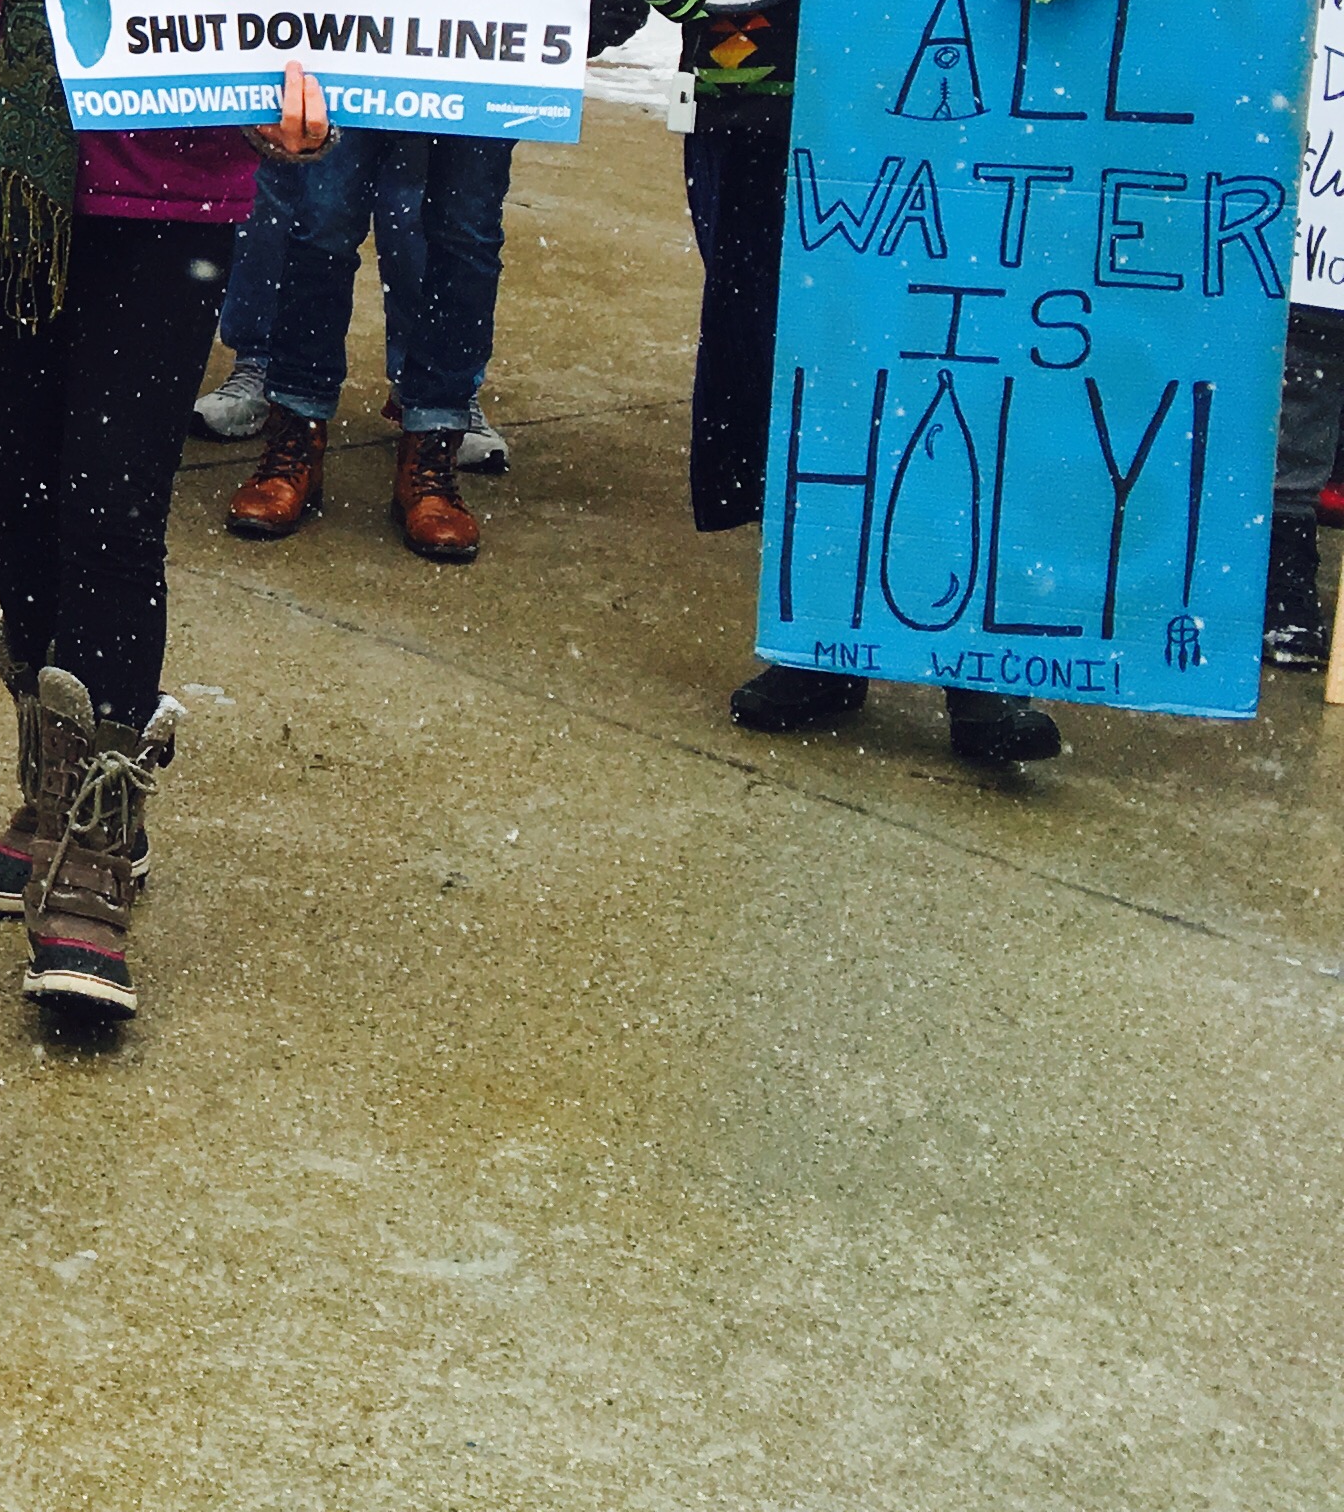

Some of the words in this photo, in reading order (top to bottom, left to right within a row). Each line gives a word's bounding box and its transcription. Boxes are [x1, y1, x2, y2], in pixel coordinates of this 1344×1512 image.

[127, 14, 227, 54] SHUT
[238, 12, 392, 54] DOWN
[406, 17, 529, 62] LINE
[541, 25, 572, 64] 5
[72, 85, 465, 121] FOODANDWATERTCH.ORG
[793, 149, 1287, 299] WATER
[898, 285, 1091, 369] IS
[780, 368, 1213, 658] HOLY!
[815, 640, 882, 673] MNI
